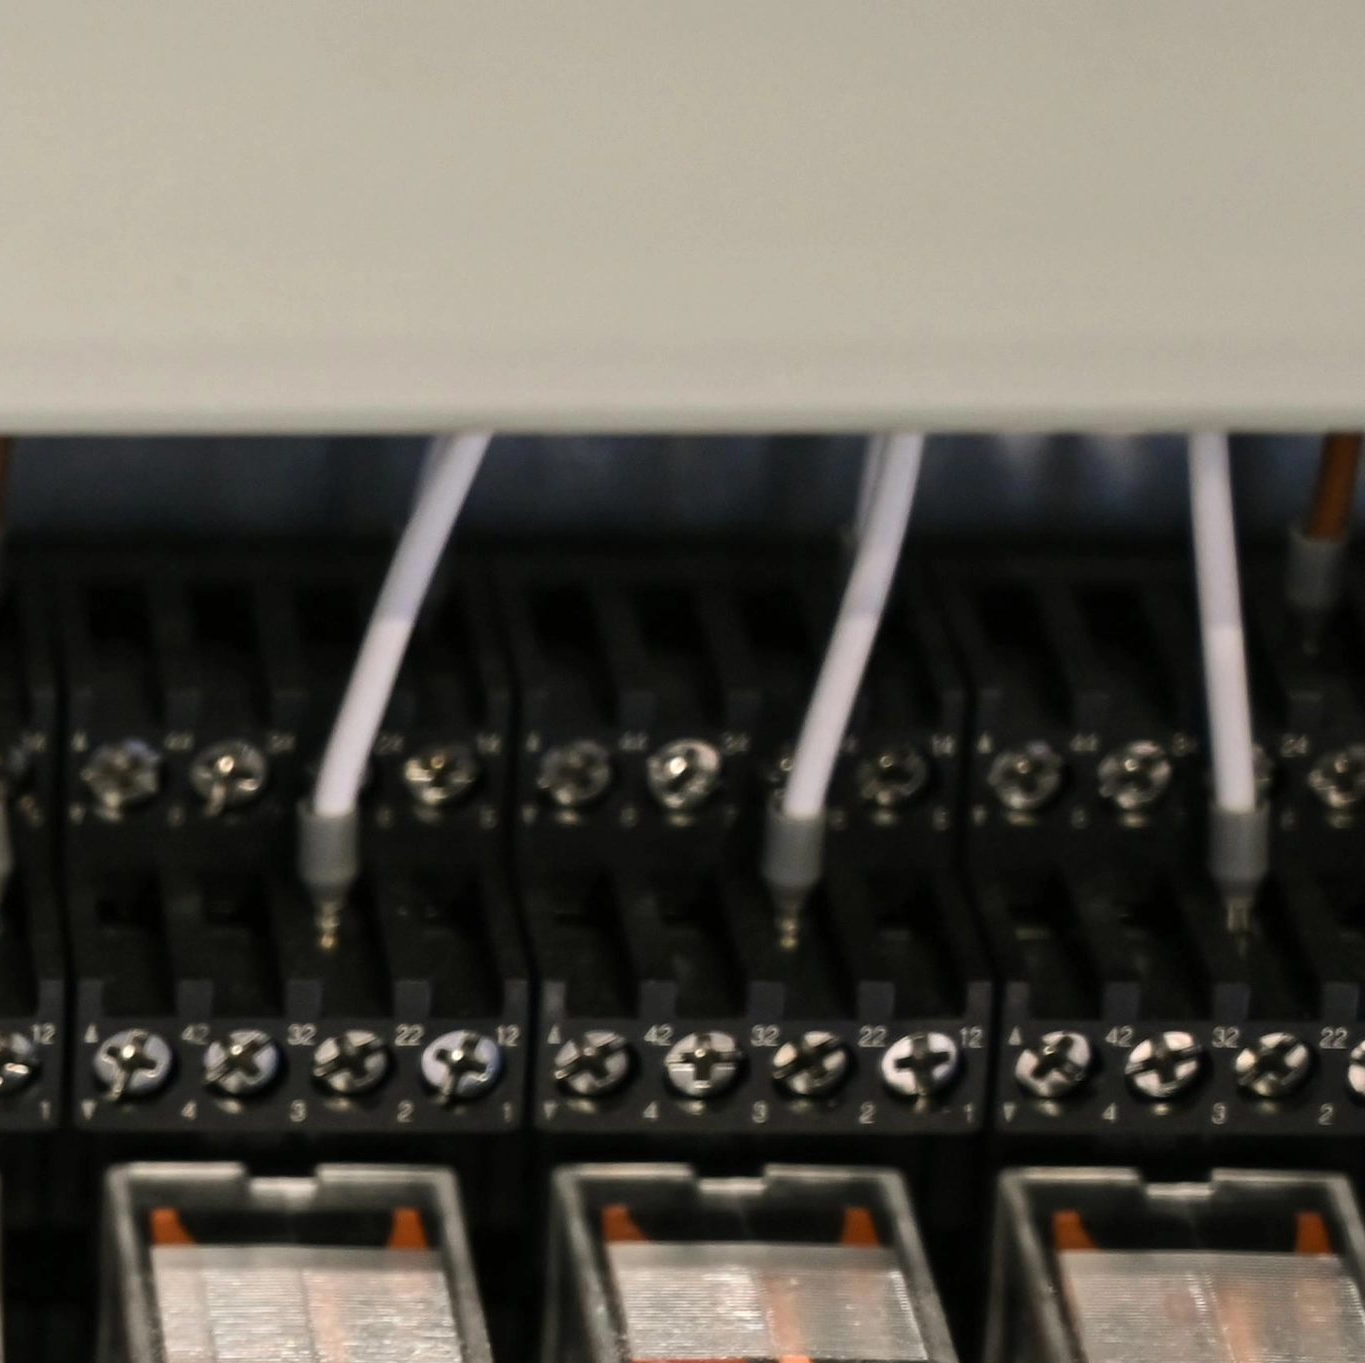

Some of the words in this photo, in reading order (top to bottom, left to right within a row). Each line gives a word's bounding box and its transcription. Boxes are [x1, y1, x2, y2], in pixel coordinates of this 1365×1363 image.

[33, 1023, 55, 1045] 12
[182, 1025, 208, 1045] 42
[288, 1024, 315, 1046] 32
[395, 1024, 423, 1047] 22
[498, 1025, 519, 1047] 12
[644, 1024, 672, 1046] 42
[751, 1024, 779, 1047] 32
[859, 1025, 886, 1048] 22
[960, 1026, 983, 1049] 12
[1105, 1025, 1133, 1048] 42
[1213, 1026, 1240, 1048] 32
[1320, 1026, 1348, 1049] 22
[181, 1100, 196, 1120] 4
[290, 1100, 305, 1122] 3
[397, 1100, 413, 1122] 2
[643, 1101, 658, 1121] 4
[752, 1101, 767, 1123] 3
[858, 1103, 874, 1124] 2
[1102, 1102, 1116, 1123] 4
[1211, 1102, 1226, 1125] 3
[1318, 1102, 1334, 1126] 2
